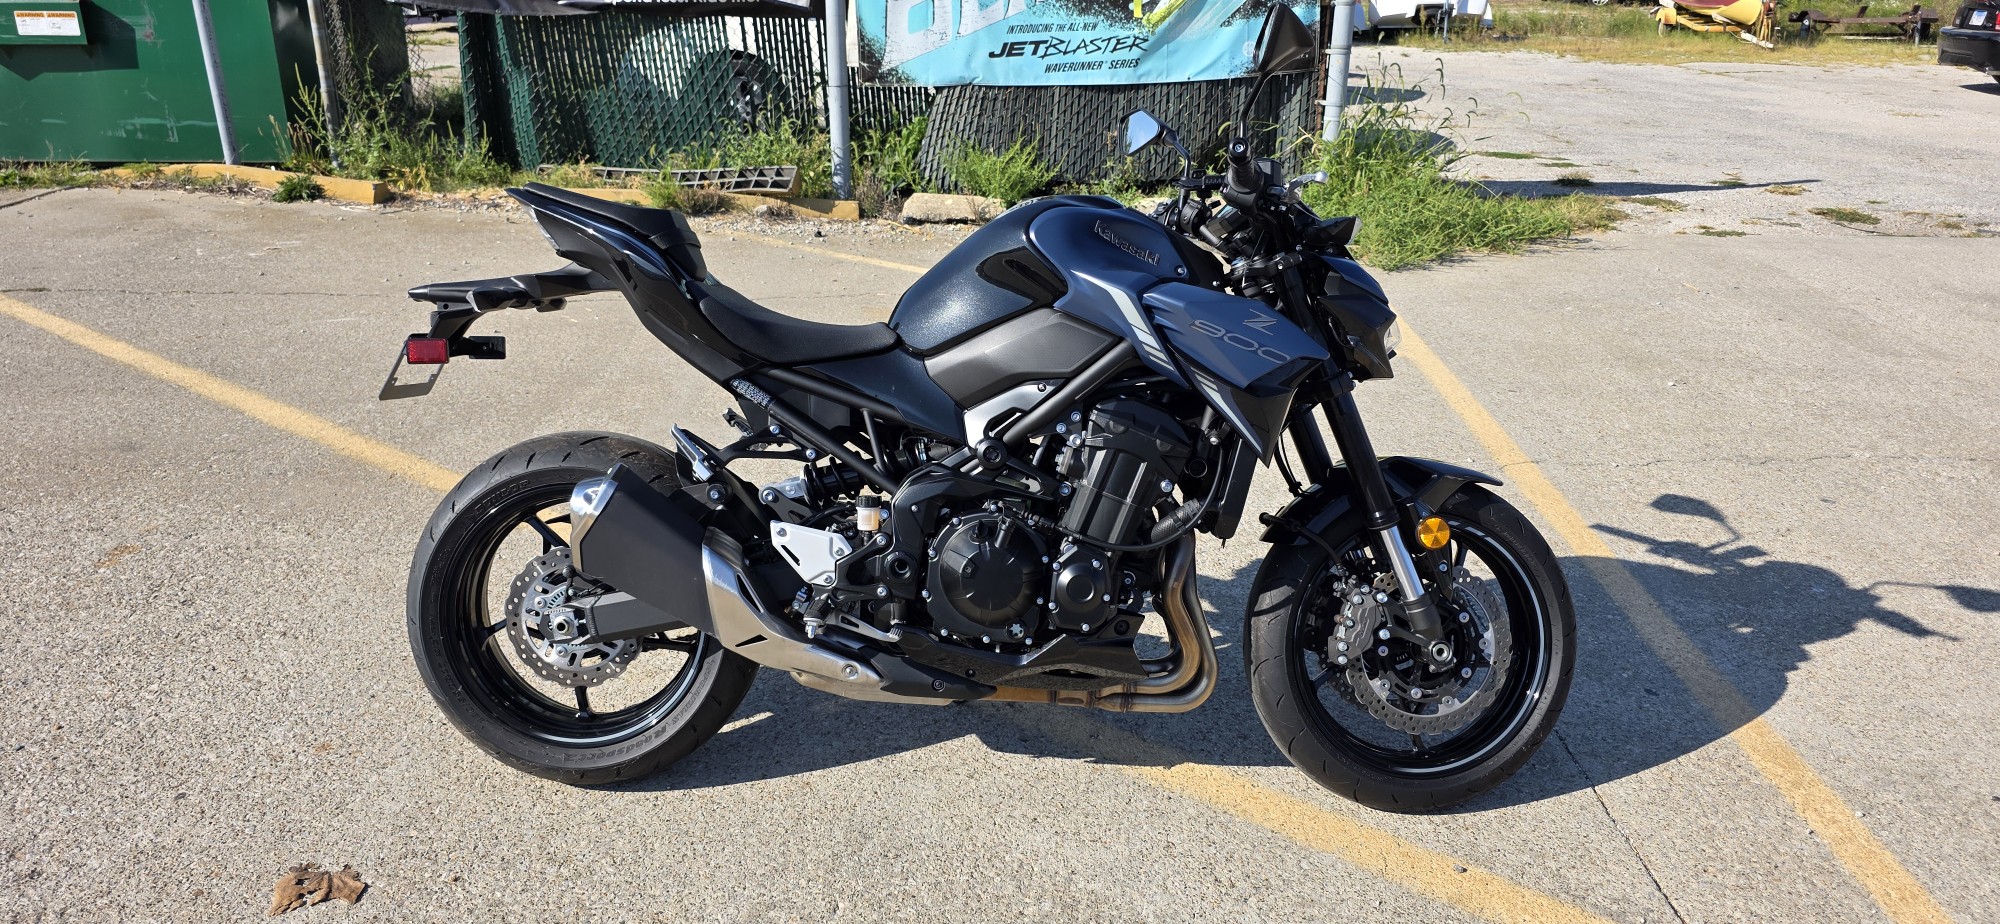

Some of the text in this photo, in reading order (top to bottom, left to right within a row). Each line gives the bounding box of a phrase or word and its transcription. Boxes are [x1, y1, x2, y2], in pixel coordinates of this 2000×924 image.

[1006, 22, 1100, 35] INTRODUCING THE ALL-NEW
[1108, 57, 1141, 70] SERIES
[1093, 219, 1160, 266] Kawasaki
[1189, 319, 1291, 364] 900
